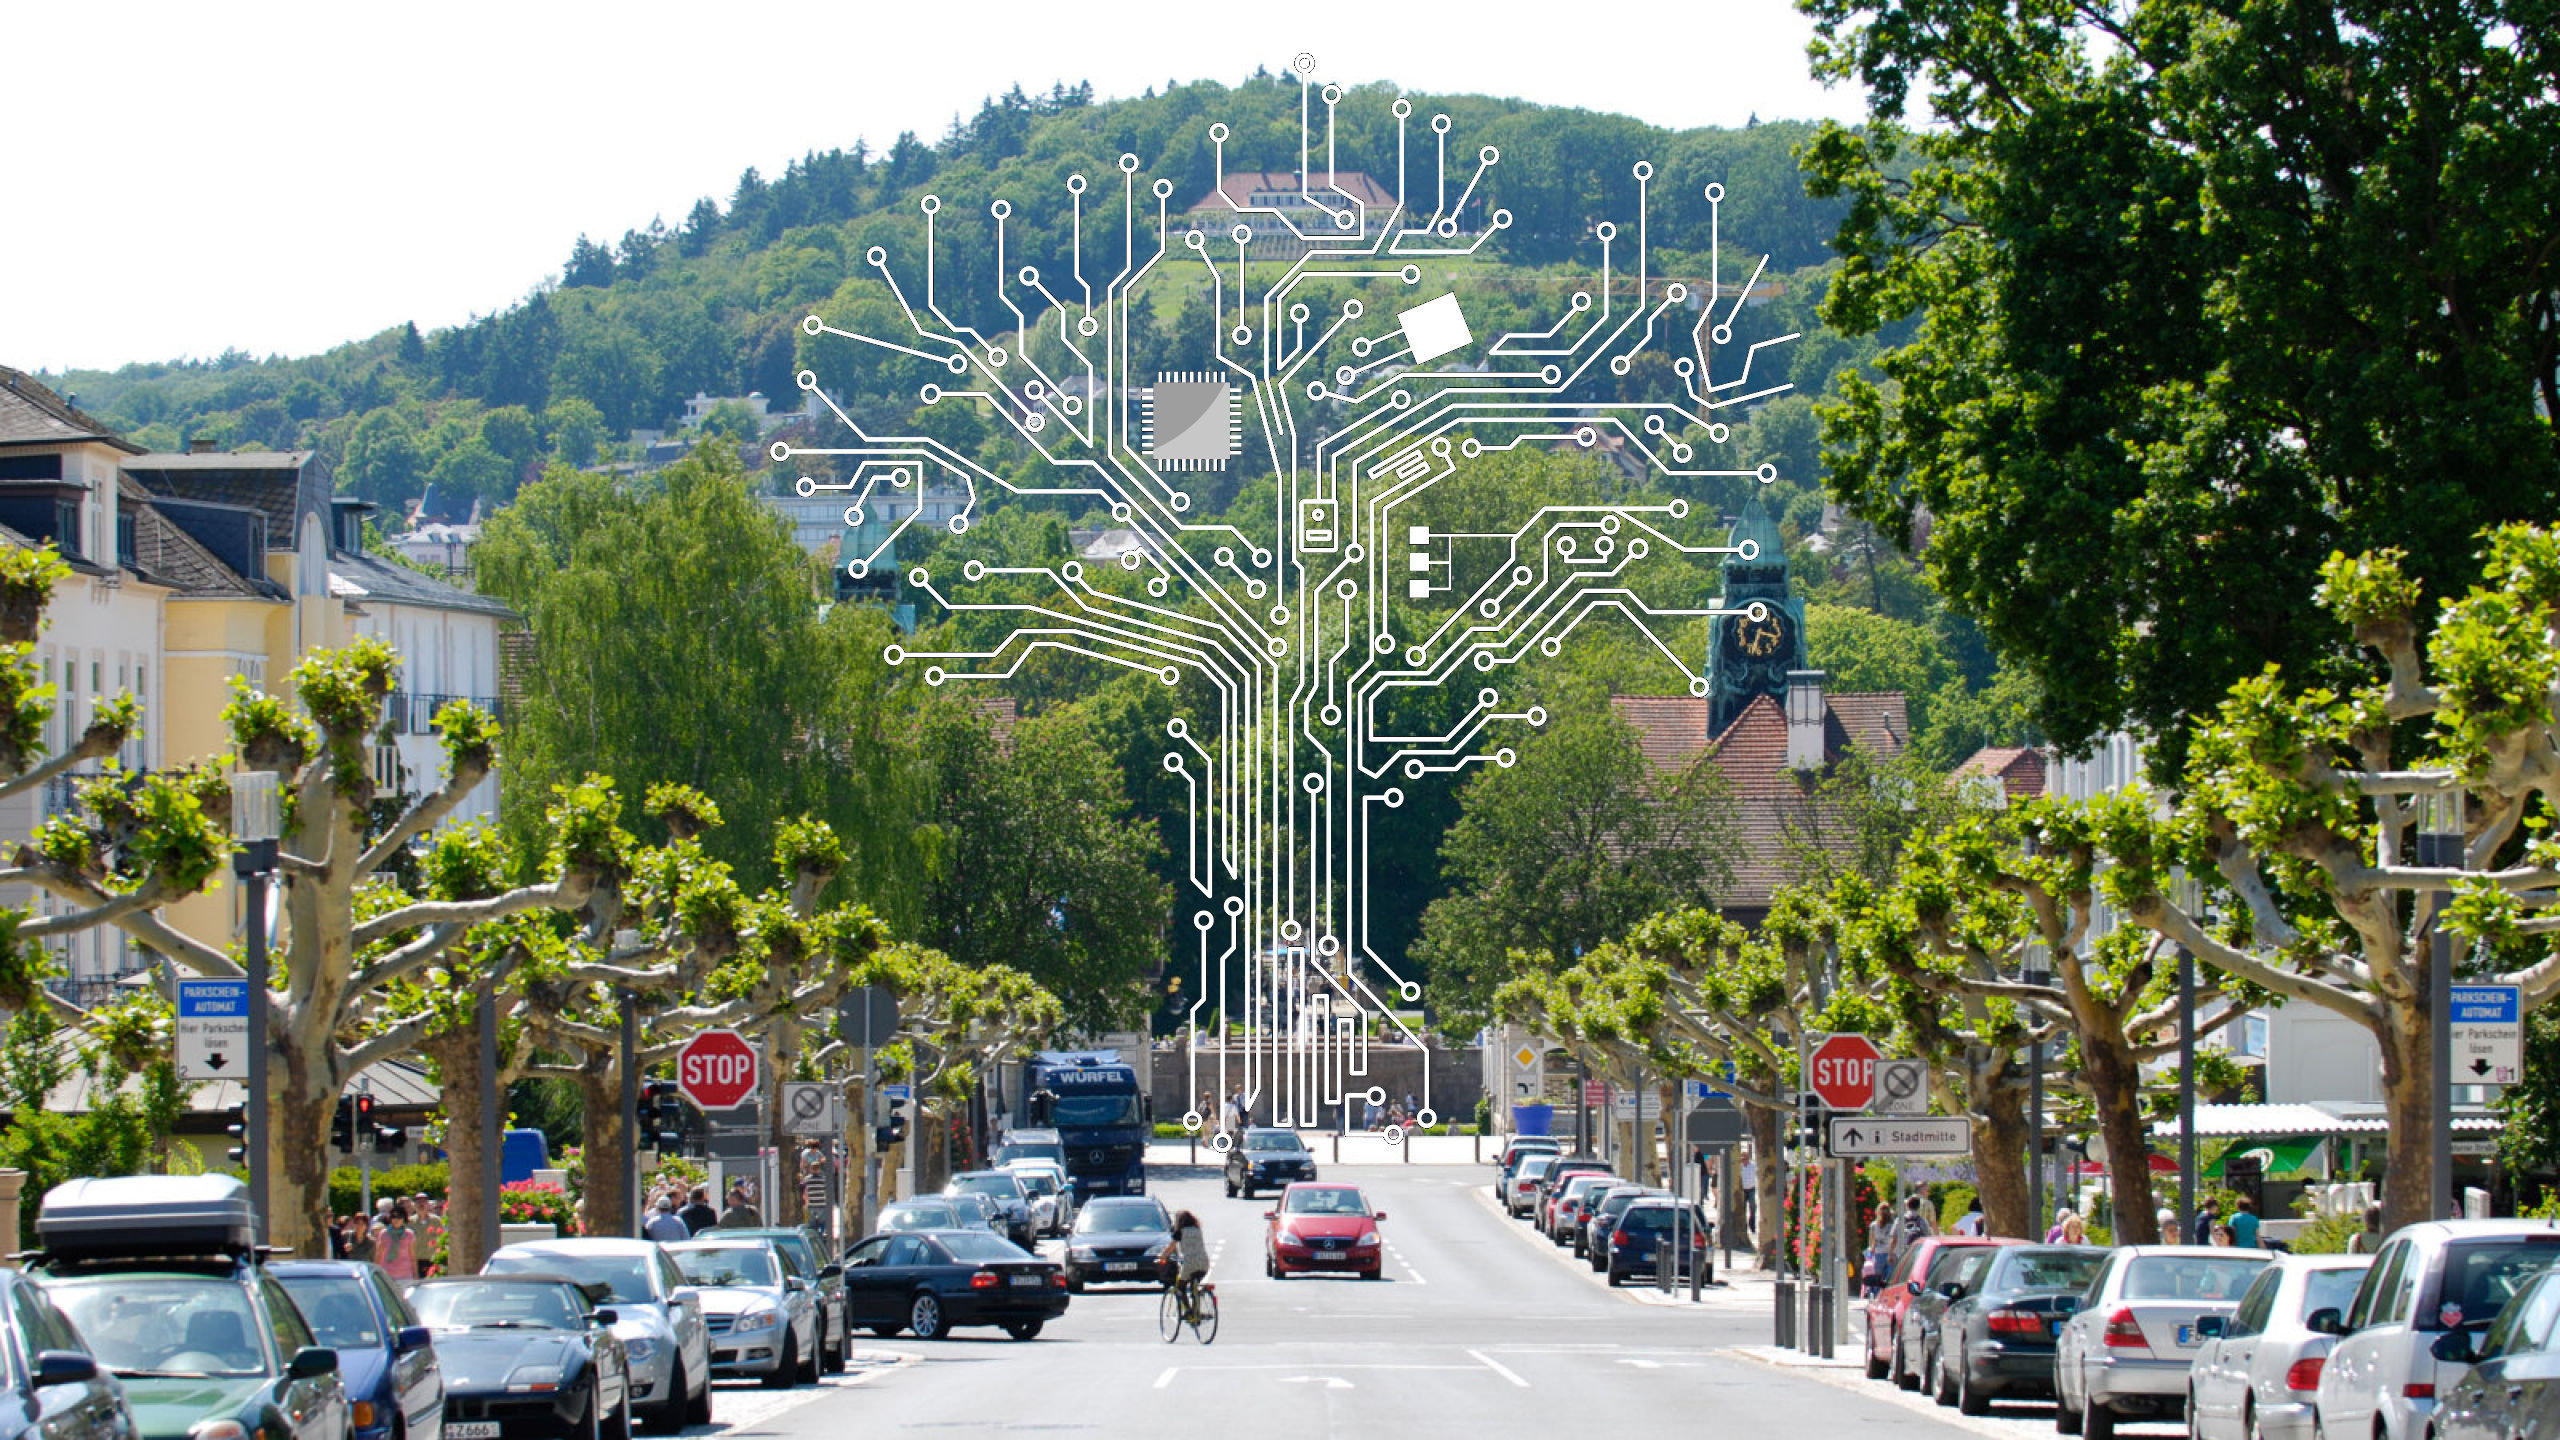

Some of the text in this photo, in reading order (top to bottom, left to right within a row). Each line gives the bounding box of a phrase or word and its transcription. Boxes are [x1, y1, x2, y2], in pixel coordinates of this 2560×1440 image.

[183, 986, 246, 998] PARKSCHEIN-
[194, 1001, 235, 1012] AUTOMAT
[2461, 1007, 2503, 1018] AUTOMAT
[180, 1023, 199, 1033] Hier
[2468, 1028, 2517, 1040] Parkschein
[180, 1065, 188, 1077] 2
[686, 1054, 751, 1086] STOP
[1818, 1058, 1873, 1087] STOP
[1891, 1130, 1957, 1143] Stadtmitte
